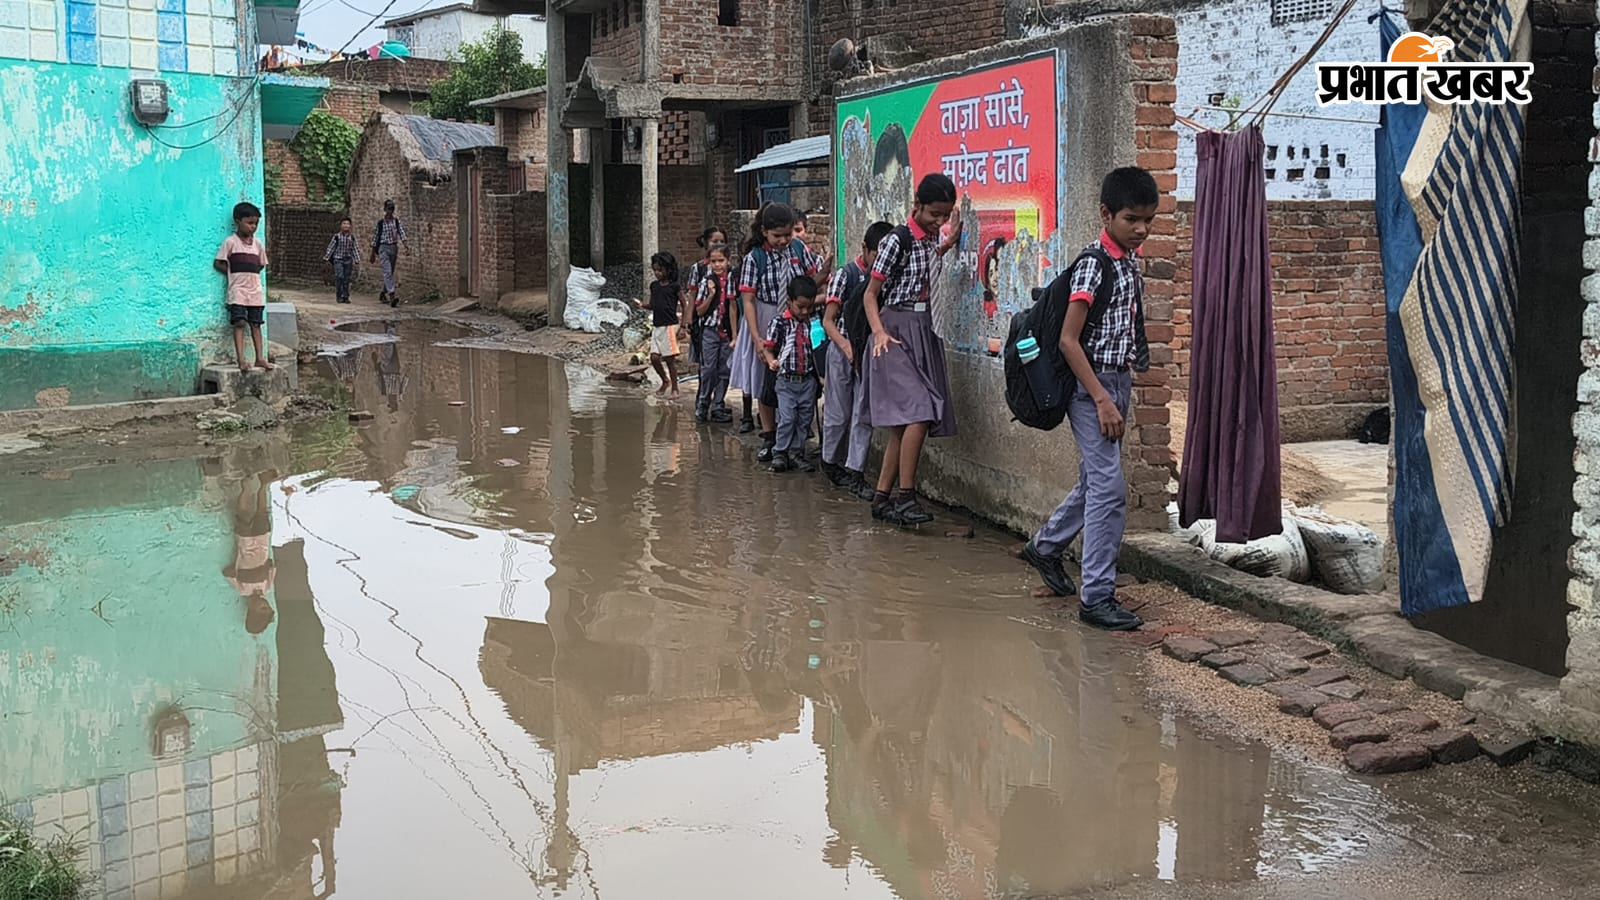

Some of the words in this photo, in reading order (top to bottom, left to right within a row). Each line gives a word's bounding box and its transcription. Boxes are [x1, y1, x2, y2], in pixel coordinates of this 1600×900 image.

[939, 96, 981, 139] ताज़ा
[983, 77, 1030, 130] सांसे,
[992, 138, 1031, 184] दांत
